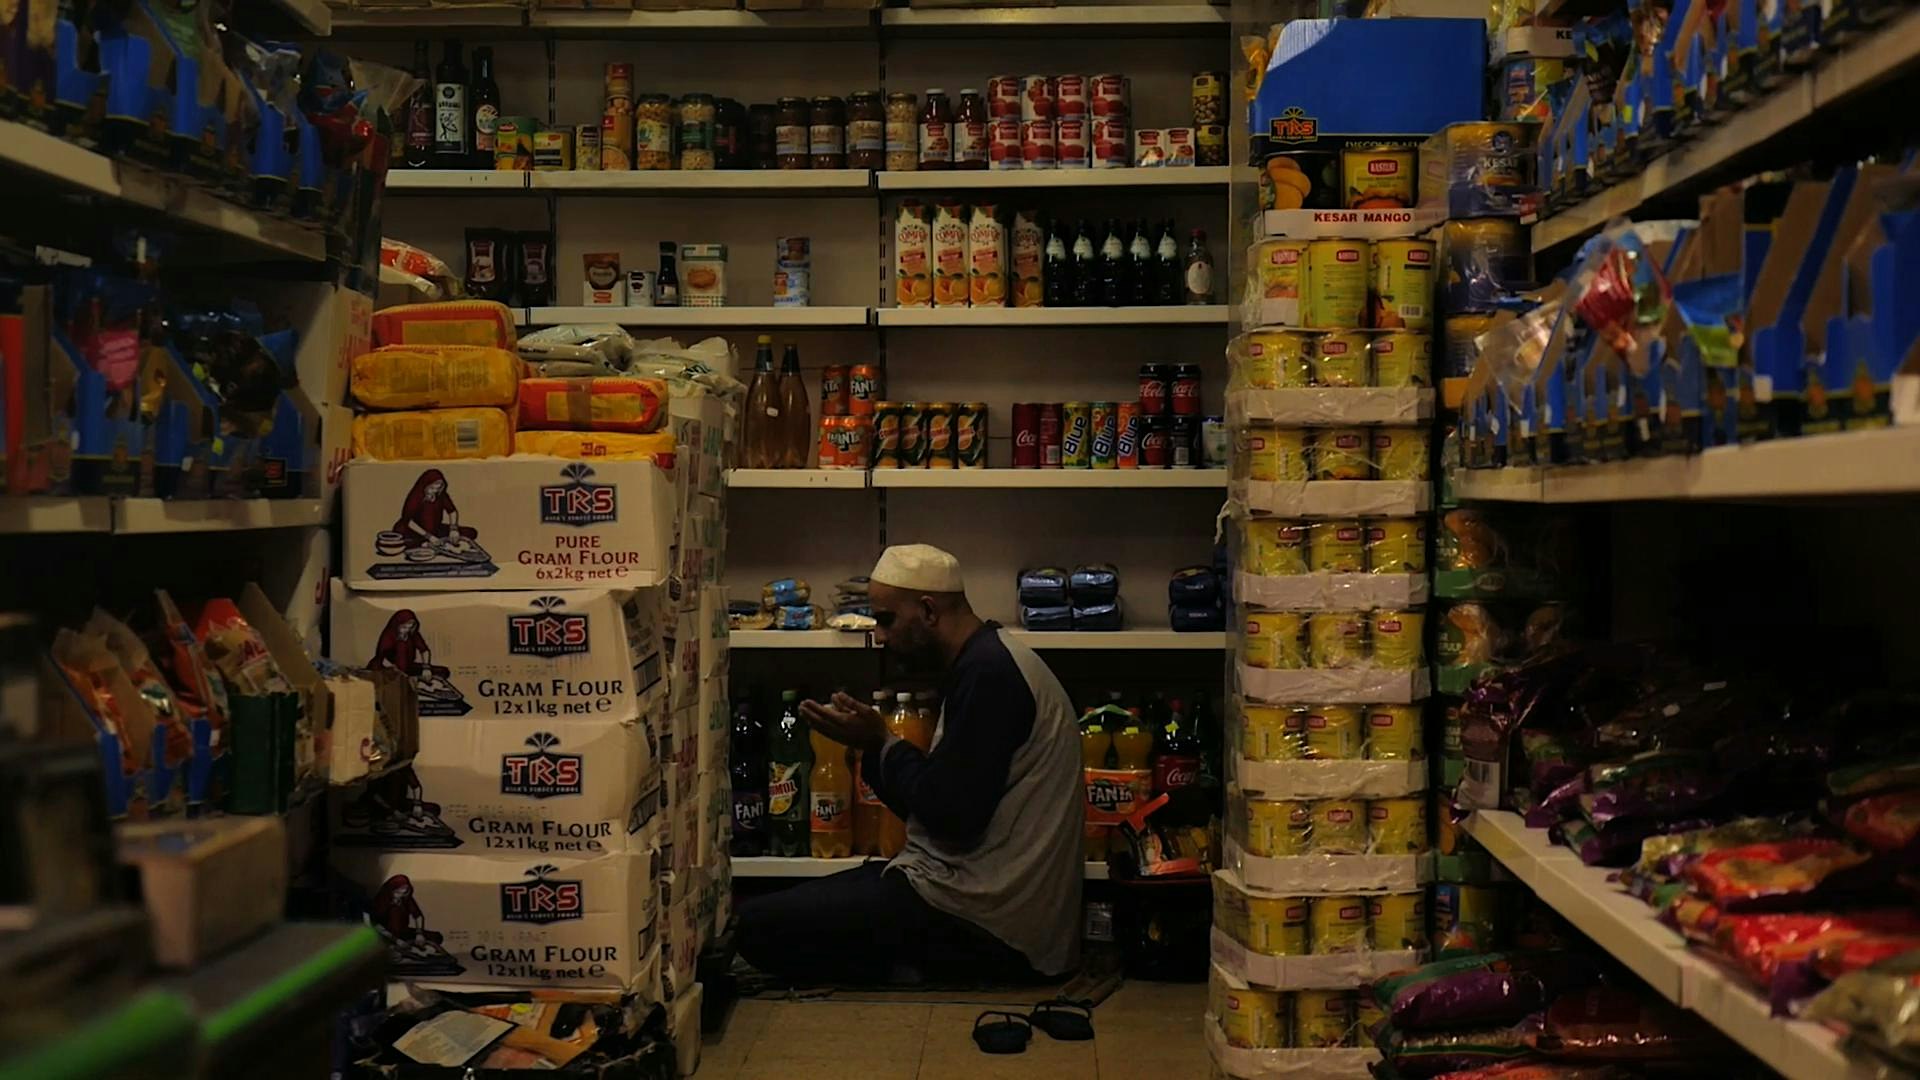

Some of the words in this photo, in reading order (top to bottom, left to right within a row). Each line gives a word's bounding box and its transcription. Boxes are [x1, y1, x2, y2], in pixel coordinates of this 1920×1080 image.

[1273, 120, 1314, 137] TRS
[1314, 212, 1358, 223] KESAR
[1363, 212, 1411, 223] MANGO
[1064, 416, 1087, 454] Blue
[1093, 416, 1116, 456] Blue
[1119, 416, 1138, 455] Blue
[544, 486, 614, 514] TRS
[555, 535, 601, 549] PURE
[518, 550, 572, 565] GRAM
[579, 550, 639, 565] FLOUR
[536, 567, 584, 582] 6x2kg
[588, 568, 612, 579] net
[512, 616, 587, 645] TRS
[478, 680, 543, 697] GRAM
[552, 679, 623, 696] FLOUR
[493, 700, 558, 717] 12x1kg
[563, 700, 592, 714] net
[506, 755, 580, 785] TRS
[1087, 784, 1133, 803] FANTA
[469, 818, 533, 835] GRAM
[542, 821, 612, 838] FLOUR
[484, 836, 549, 853] 12x1kg
[554, 839, 581, 851] net
[505, 883, 580, 912] TRS
[471, 946, 535, 962] GRAM
[545, 945, 617, 962] FLOUR
[487, 964, 552, 980] 12x1kg
[556, 967, 586, 978] net
